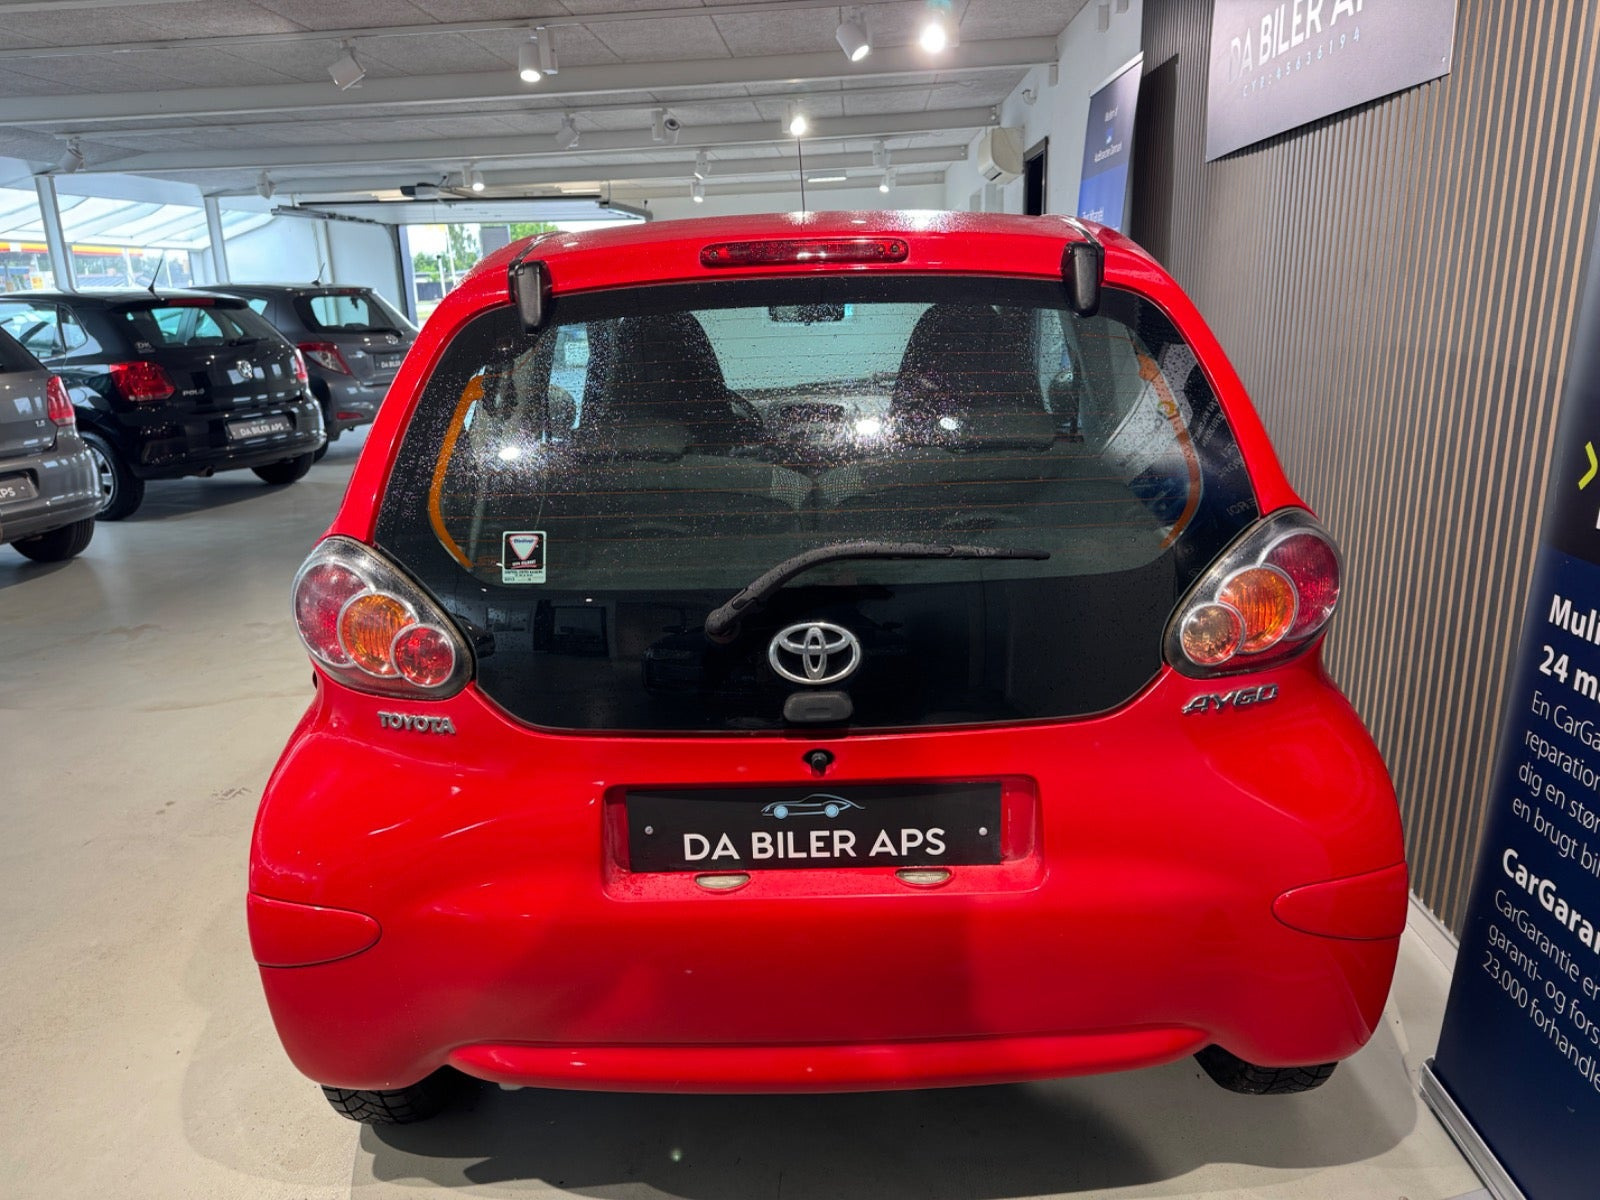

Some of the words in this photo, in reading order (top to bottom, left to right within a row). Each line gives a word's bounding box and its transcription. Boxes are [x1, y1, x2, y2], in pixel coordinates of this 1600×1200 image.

[1182, 683, 1278, 714] AYGO
[1539, 644, 1569, 684] 24
[1573, 668, 1600, 702] m
[377, 710, 456, 734] TOYOTA
[1531, 690, 1551, 720] En
[1553, 705, 1600, 752] CarGa
[1518, 761, 1543, 797] dig
[1545, 783, 1566, 809] en
[683, 832, 740, 861] DA
[752, 830, 857, 859] BILER
[869, 828, 946, 857] APS
[1513, 797, 1531, 822] en
[1533, 803, 1578, 860] brugt
[1495, 889, 1580, 983] CarGarantie
[1481, 950, 1529, 1008] 23.000
[1488, 924, 1543, 983] garanti-
[1545, 981, 1567, 1014] og
[1569, 999, 1600, 1049] fors
